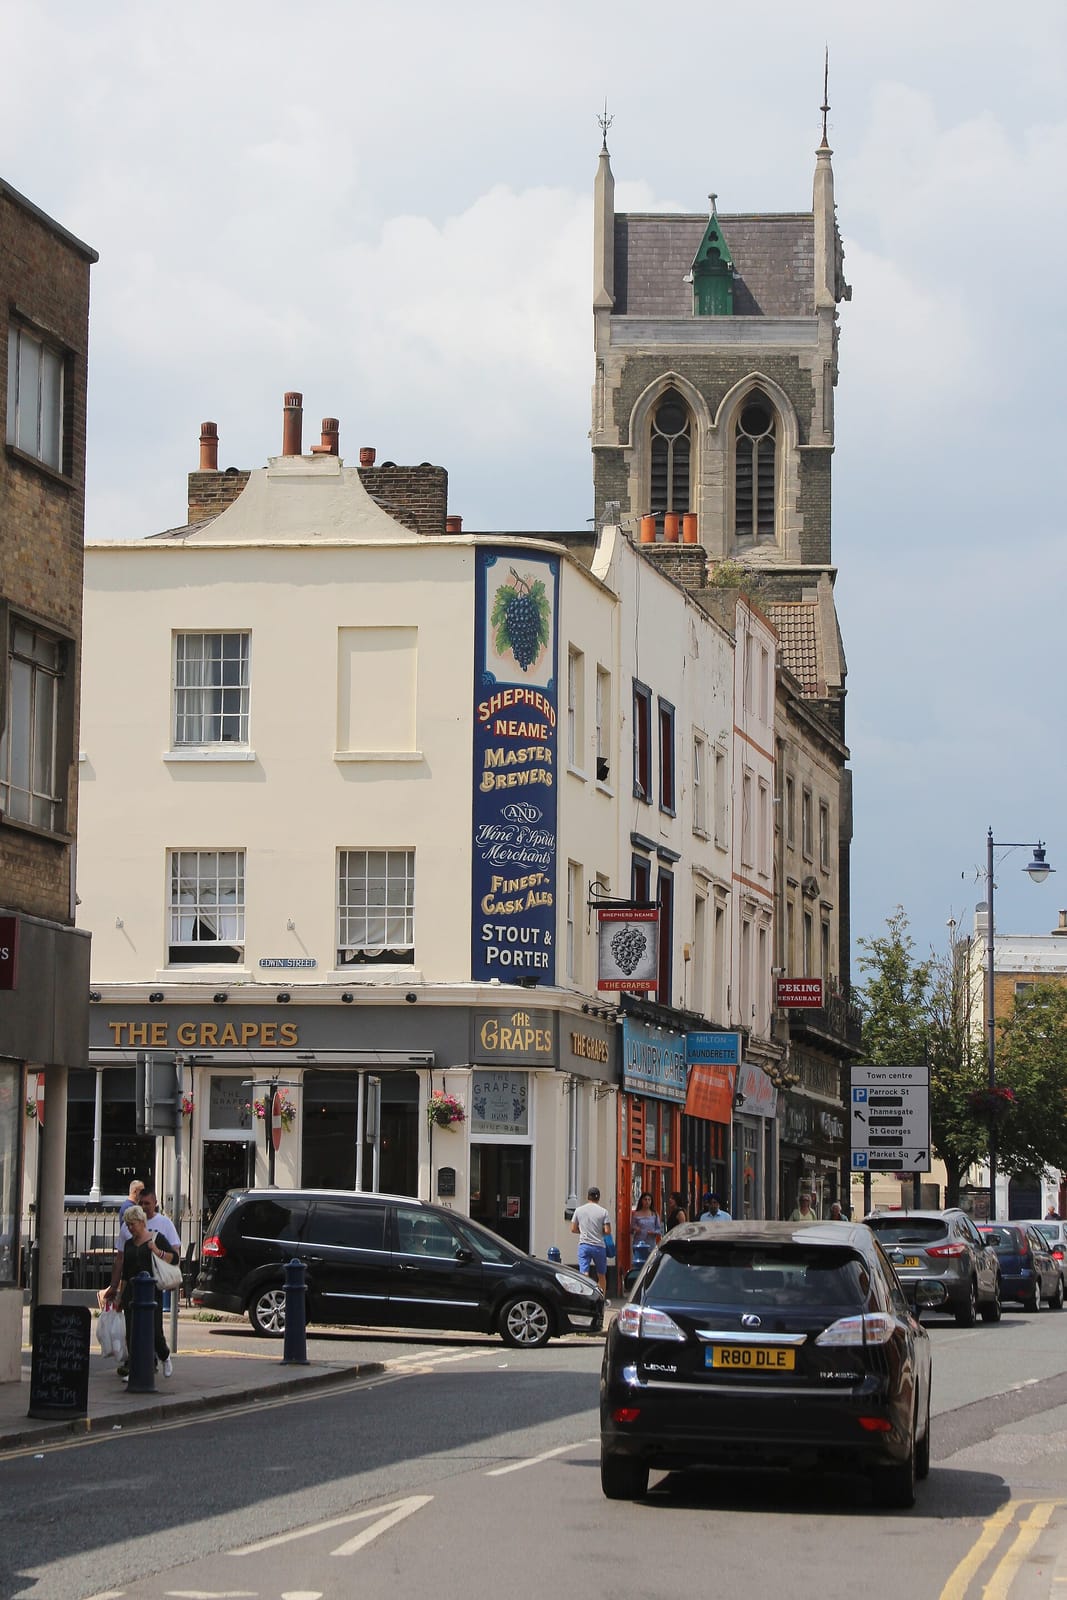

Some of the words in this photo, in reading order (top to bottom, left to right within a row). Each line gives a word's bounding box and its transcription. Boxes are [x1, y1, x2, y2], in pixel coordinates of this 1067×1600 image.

[477, 688, 556, 727] SHEPHERD
[495, 719, 548, 740] NEAME
[484, 746, 552, 768] MASTER
[480, 768, 552, 792] BREWERS
[504, 803, 540, 822] AND
[477, 824, 516, 844] Wine
[526, 830, 554, 848] Spirit
[482, 844, 551, 865] Merchants
[491, 873, 545, 893] FINEST
[481, 893, 524, 915] CASK
[525, 890, 553, 910] ALES
[482, 923, 540, 944] STOUT
[543, 930, 552, 945] &
[261, 959, 283, 967] EDWIN
[287, 959, 315, 967] STREET
[486, 946, 549, 968] PORTER
[778, 984, 821, 992] PEKING
[510, 1012, 531, 1026] THE
[109, 1022, 168, 1046] THE
[177, 1022, 298, 1047] GRAPES
[480, 1019, 552, 1052] GRAPES
[695, 1036, 727, 1044] MILTON
[571, 1032, 586, 1057] THE
[586, 1036, 609, 1063] GRAPES
[688, 1049, 736, 1058] LAUNDERETTE
[626, 1038, 662, 1077] LAUNDRY
[663, 1048, 685, 1084] CARE
[473, 1082, 526, 1097] GRAPES
[869, 1108, 913, 1116] Thamesgate
[643, 1363, 677, 1372] LEXUS
[721, 1349, 752, 1365] R80
[756, 1350, 787, 1367] DLE
